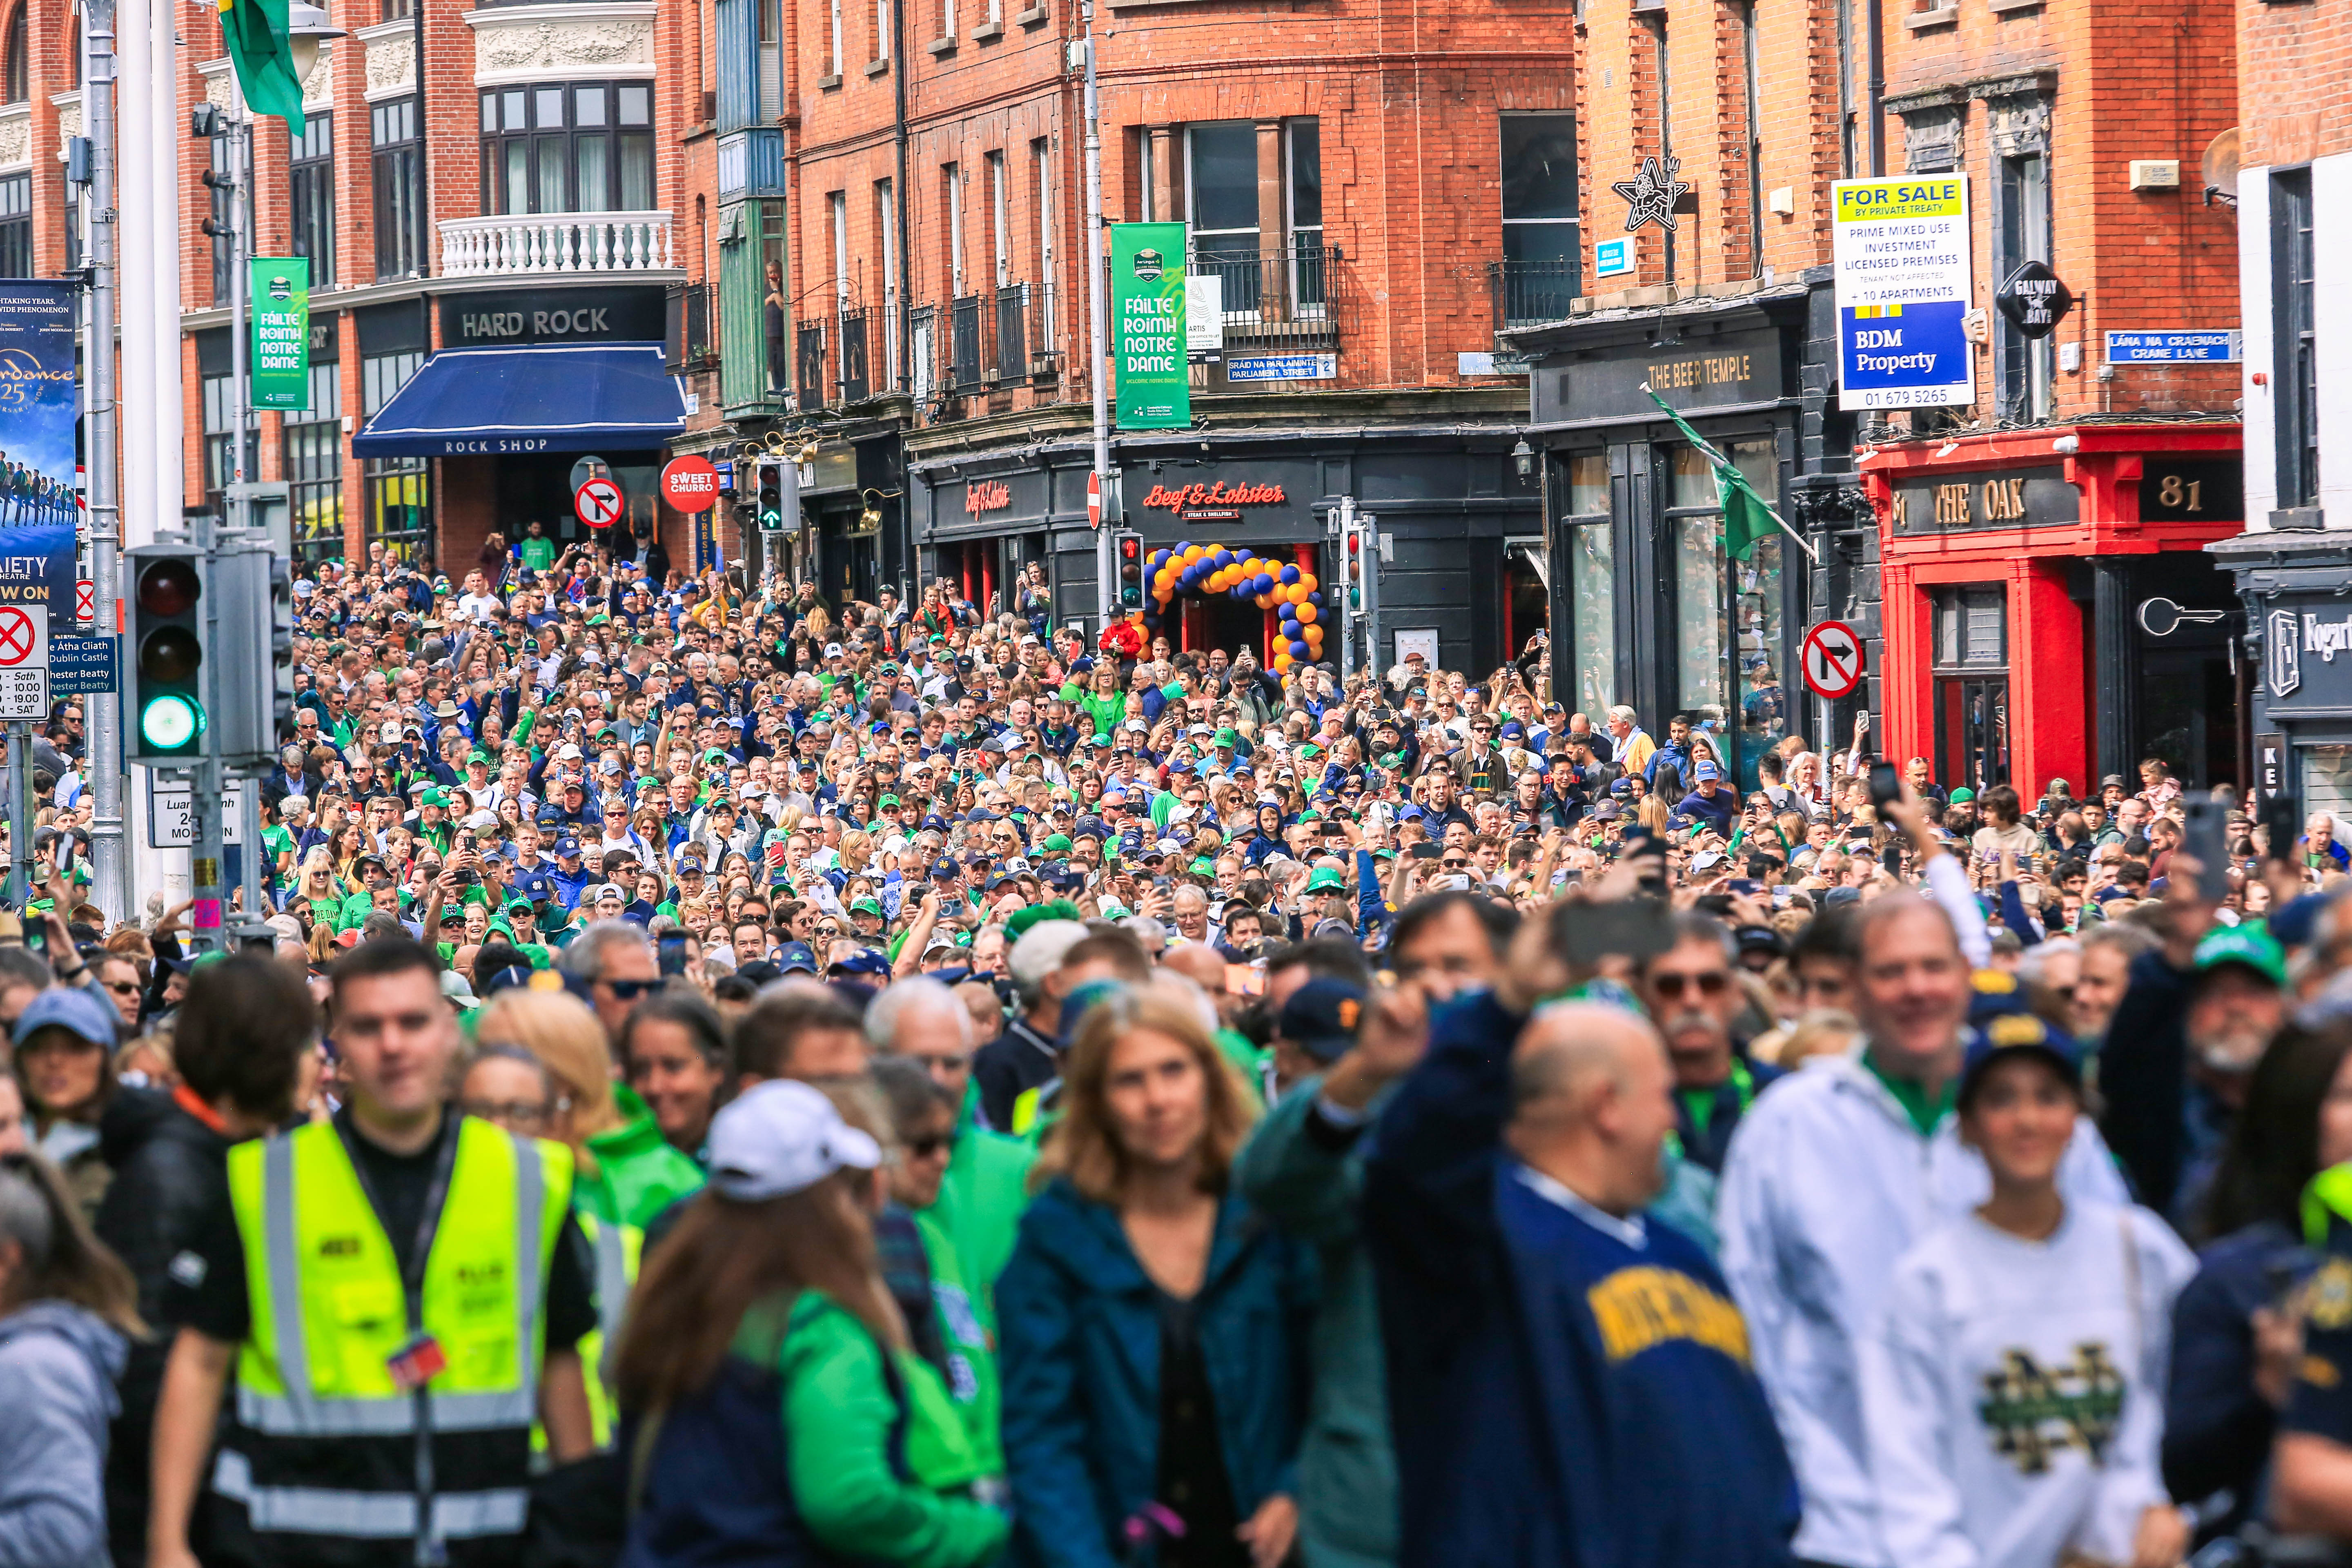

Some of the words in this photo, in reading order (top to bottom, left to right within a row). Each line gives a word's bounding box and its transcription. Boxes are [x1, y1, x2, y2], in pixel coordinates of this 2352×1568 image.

[1842, 189, 1889, 205] FOR
[1898, 185, 1955, 203] SALE
[1855, 208, 1866, 216] BY
[1869, 205, 1907, 216] PRIVATE
[1910, 203, 1944, 213] TREATY
[1850, 227, 1884, 238] PRIME
[1889, 225, 1926, 236] MIXED
[1930, 223, 1950, 234] USE
[1865, 240, 1936, 253] INVESTMENT
[1845, 258, 1899, 270] LICENSED
[1902, 254, 1958, 267] PREMISES
[1860, 274, 1888, 283] TENANT
[1907, 272, 1945, 281] AFFECTED
[1864, 290, 1876, 301] 10
[1880, 286, 1954, 300] APARTMENTS
[2014, 279, 2058, 295] GALWAY
[462, 312, 523, 337] HARD
[533, 308, 609, 334] ROCK
[2027, 309, 2048, 324] BAY
[1125, 336, 1177, 353] NOTRE
[1855, 328, 1903, 350] BDM
[2110, 334, 2141, 347] LÁNA
[2146, 336, 2163, 346] NA
[2131, 348, 2172, 359] CRANE
[2177, 348, 2208, 359] LANE
[1127, 356, 1176, 372] DAME
[1229, 360, 1252, 370] SRÁID
[1266, 359, 1317, 368] PARLAIMINTE
[1323, 361, 1330, 372] 2
[1856, 352, 1937, 375] Property
[1232, 369, 1279, 378] PARLIAMENT
[1283, 368, 1313, 376] STREET
[1649, 364, 1670, 389] THE
[1673, 361, 1702, 388] BEER
[1704, 355, 1751, 383] TEMPLE
[0, 383, 24, 404] 25
[1866, 393, 1880, 405] 01
[1886, 391, 1909, 404] 679
[1915, 389, 1947, 403] 5265
[445, 441, 488, 452] ROCK
[499, 439, 547, 451] SHOP
[670, 472, 713, 484] SWEET
[670, 483, 713, 493] CHURRO
[2160, 475, 2203, 511] 81
[1143, 485, 1191, 514] Beef
[1189, 483, 1206, 505] &
[1205, 481, 1284, 504] Lobster
[1933, 483, 1970, 524] THE
[1984, 478, 2025, 521] OAK
[23, 586, 49, 600] ON
[57, 641, 79, 651] Átha
[82, 641, 108, 650] Cliath
[49, 654, 79, 663] Dublin
[82, 653, 108, 662] Castle
[14, 672, 36, 680] Sath
[80, 669, 109, 679] Beatty
[15, 683, 40, 692] 10.00
[80, 681, 109, 690] Beatty
[14, 694, 39, 703] 19.00
[17, 705, 35, 714] SAT
[683, 858, 697, 867] ND
[444, 905, 457, 915] ND
